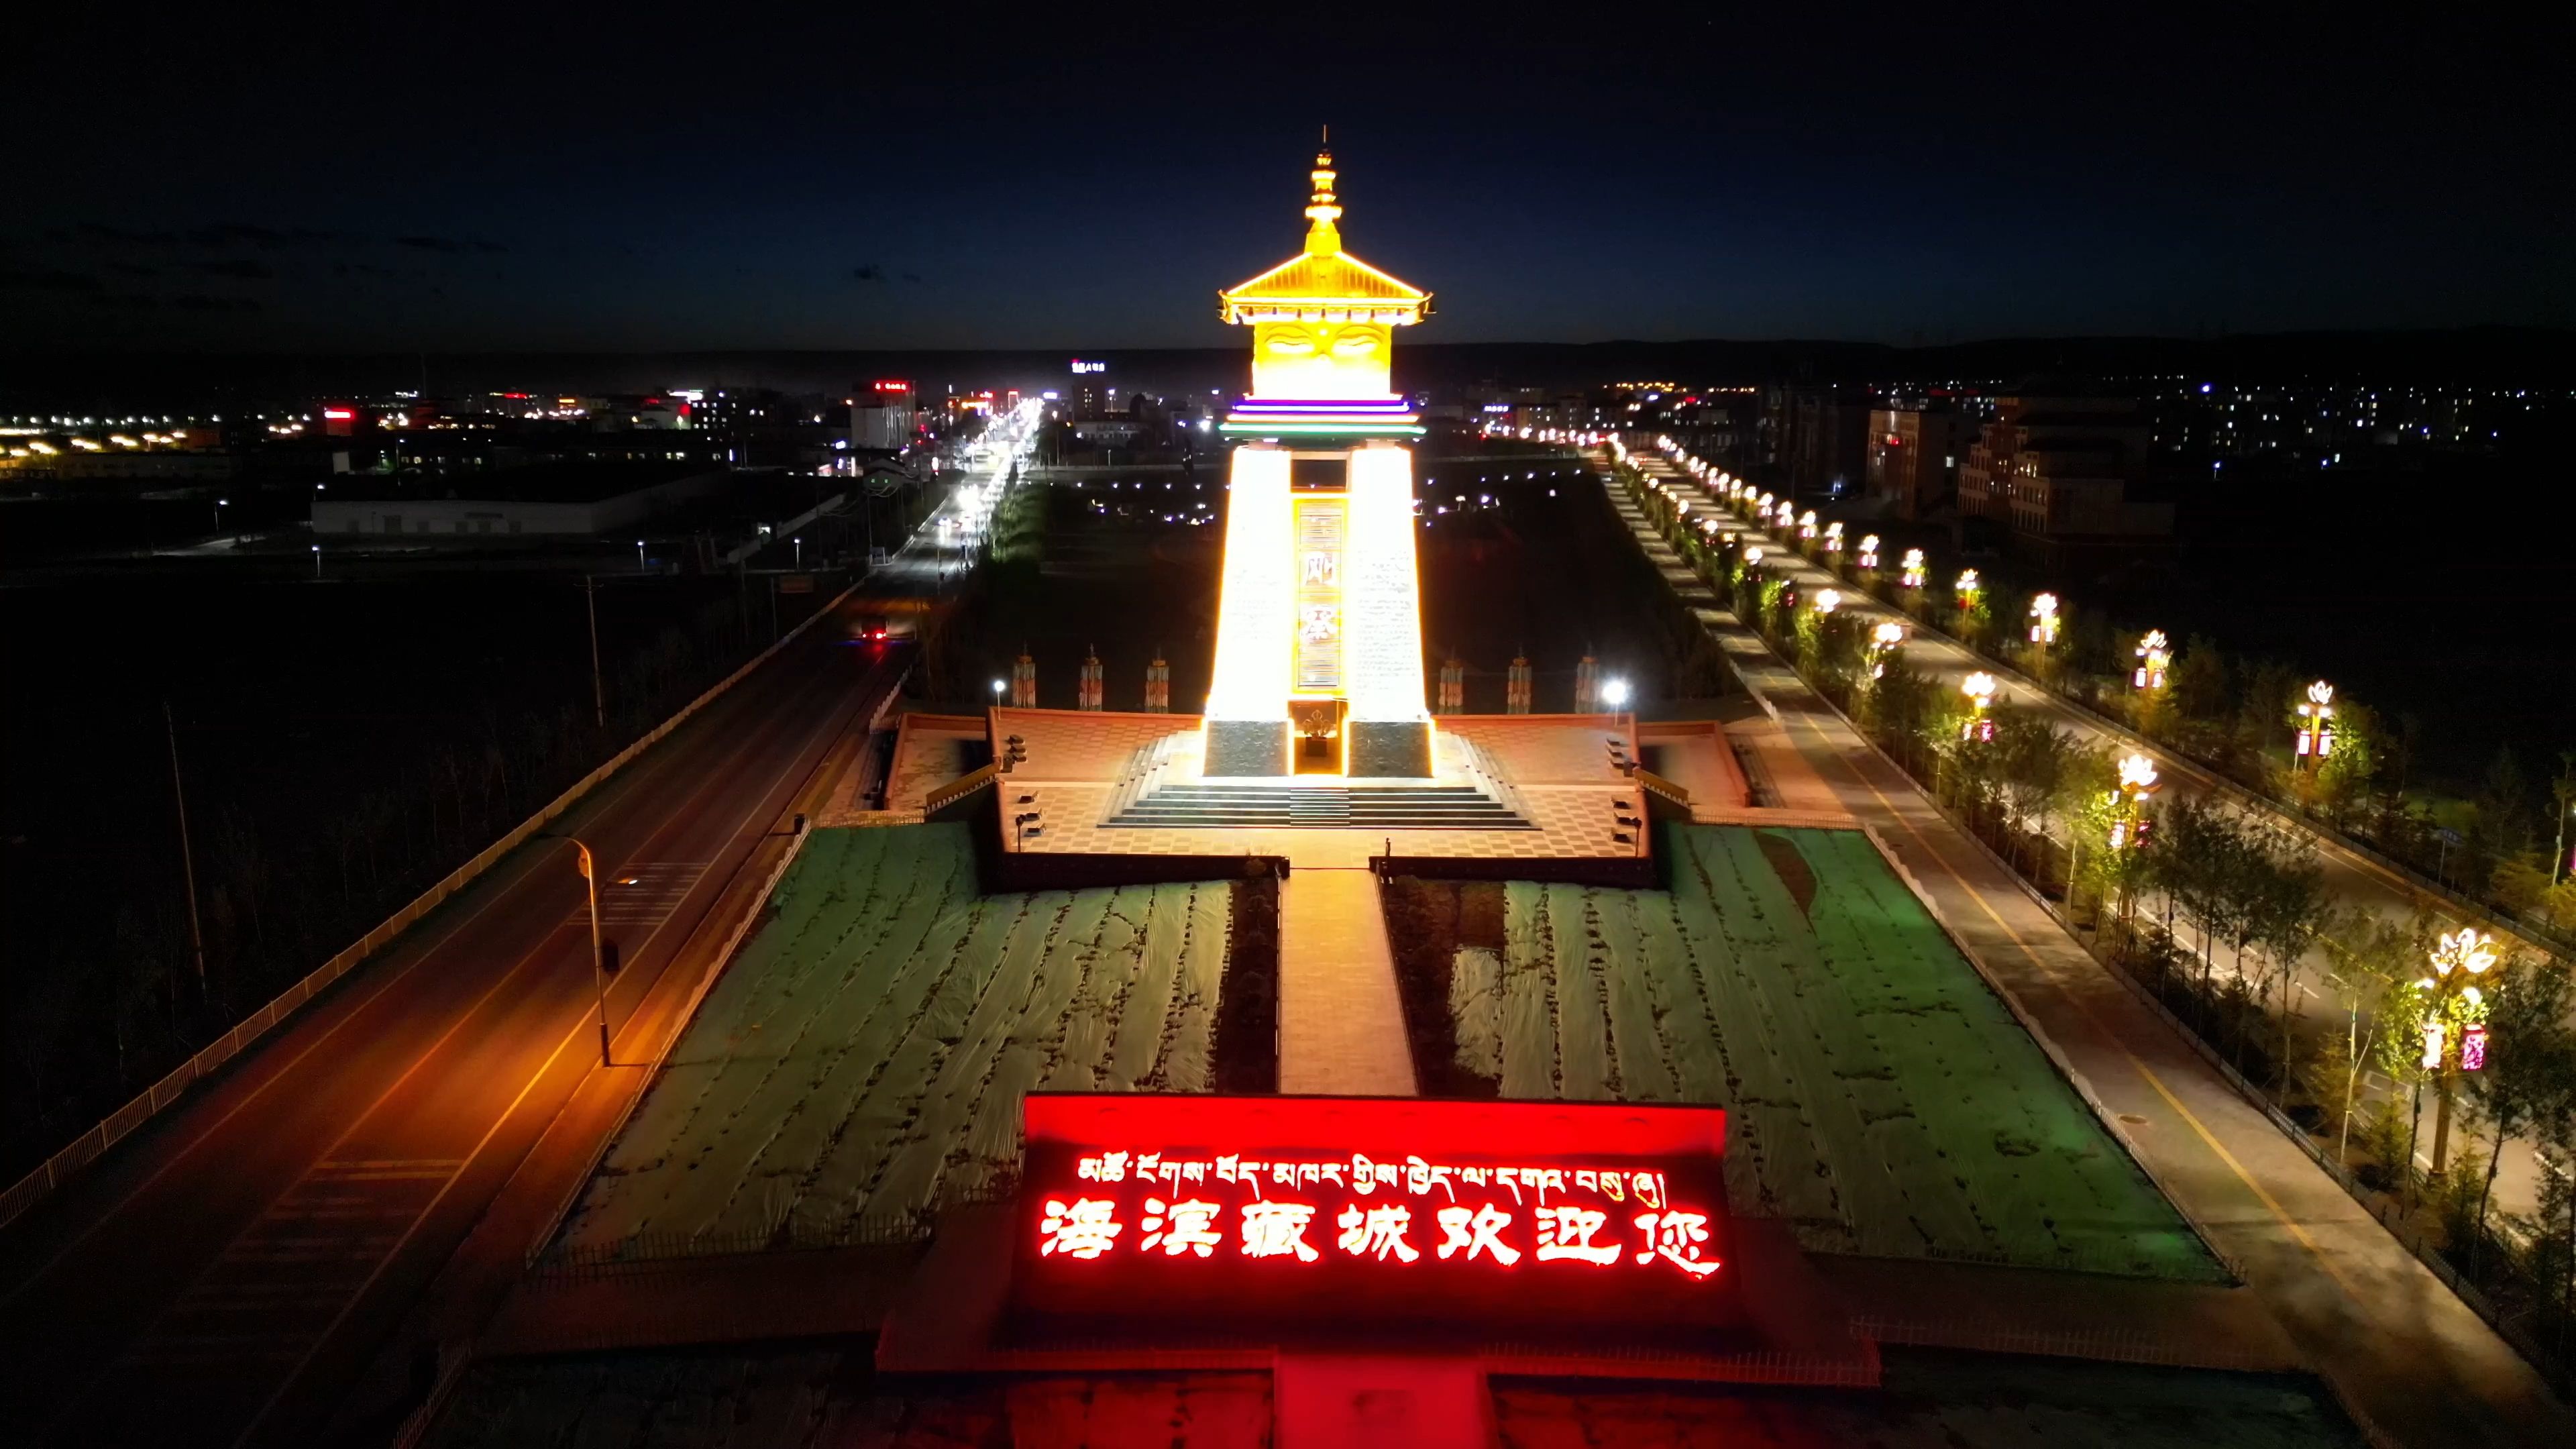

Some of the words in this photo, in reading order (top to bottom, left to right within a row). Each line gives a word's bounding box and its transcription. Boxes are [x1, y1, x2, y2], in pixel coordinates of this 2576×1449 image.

[1041, 1197, 1720, 1279] 海滨藏城欢迎您
